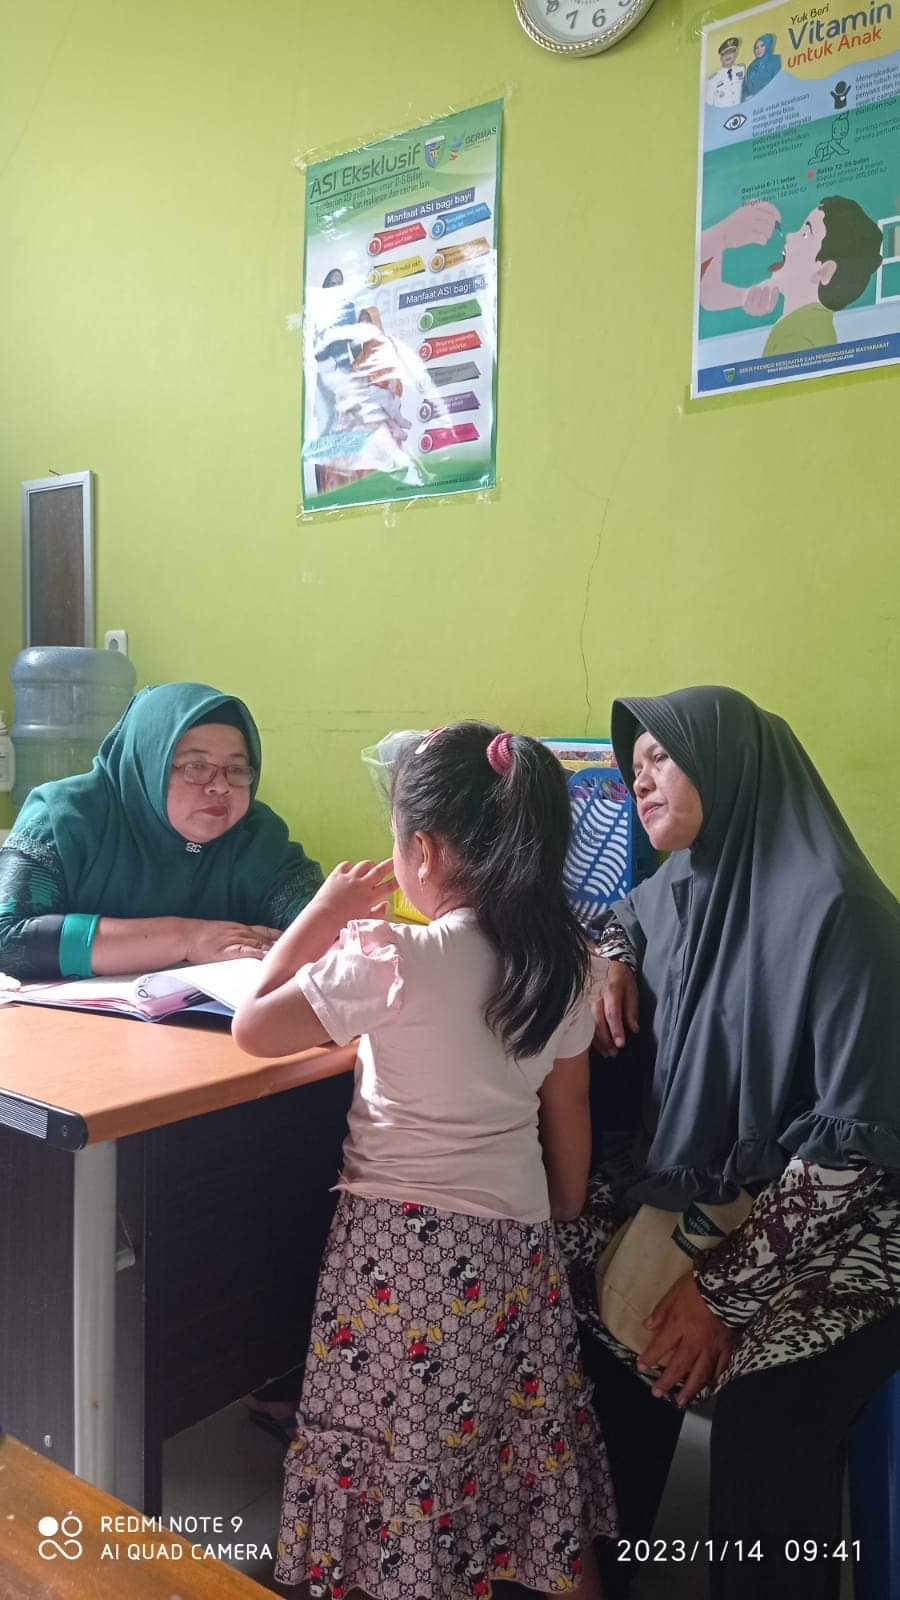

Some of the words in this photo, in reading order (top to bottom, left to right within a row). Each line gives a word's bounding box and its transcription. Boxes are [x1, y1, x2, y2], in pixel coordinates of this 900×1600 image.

[566, 10, 579, 29] 7
[592, 8, 606, 28] 6
[789, 1, 892, 50] Vitamin
[790, 13, 809, 25] Yuk
[810, 4, 829, 20] Beri
[787, 42, 833, 68] untuk
[838, 27, 882, 53] Anak
[465, 127, 497, 144] GERMAS
[310, 171, 337, 199] ASI
[342, 143, 421, 186] Eksklusif
[387, 206, 418, 225] Manfaat
[420, 203, 434, 215] ASI
[436, 198, 453, 210] bagi
[455, 193, 472, 206] bayi
[406, 290, 436, 305] Manfaat
[437, 286, 452, 298] ASI
[453, 282, 470, 295] bagi
